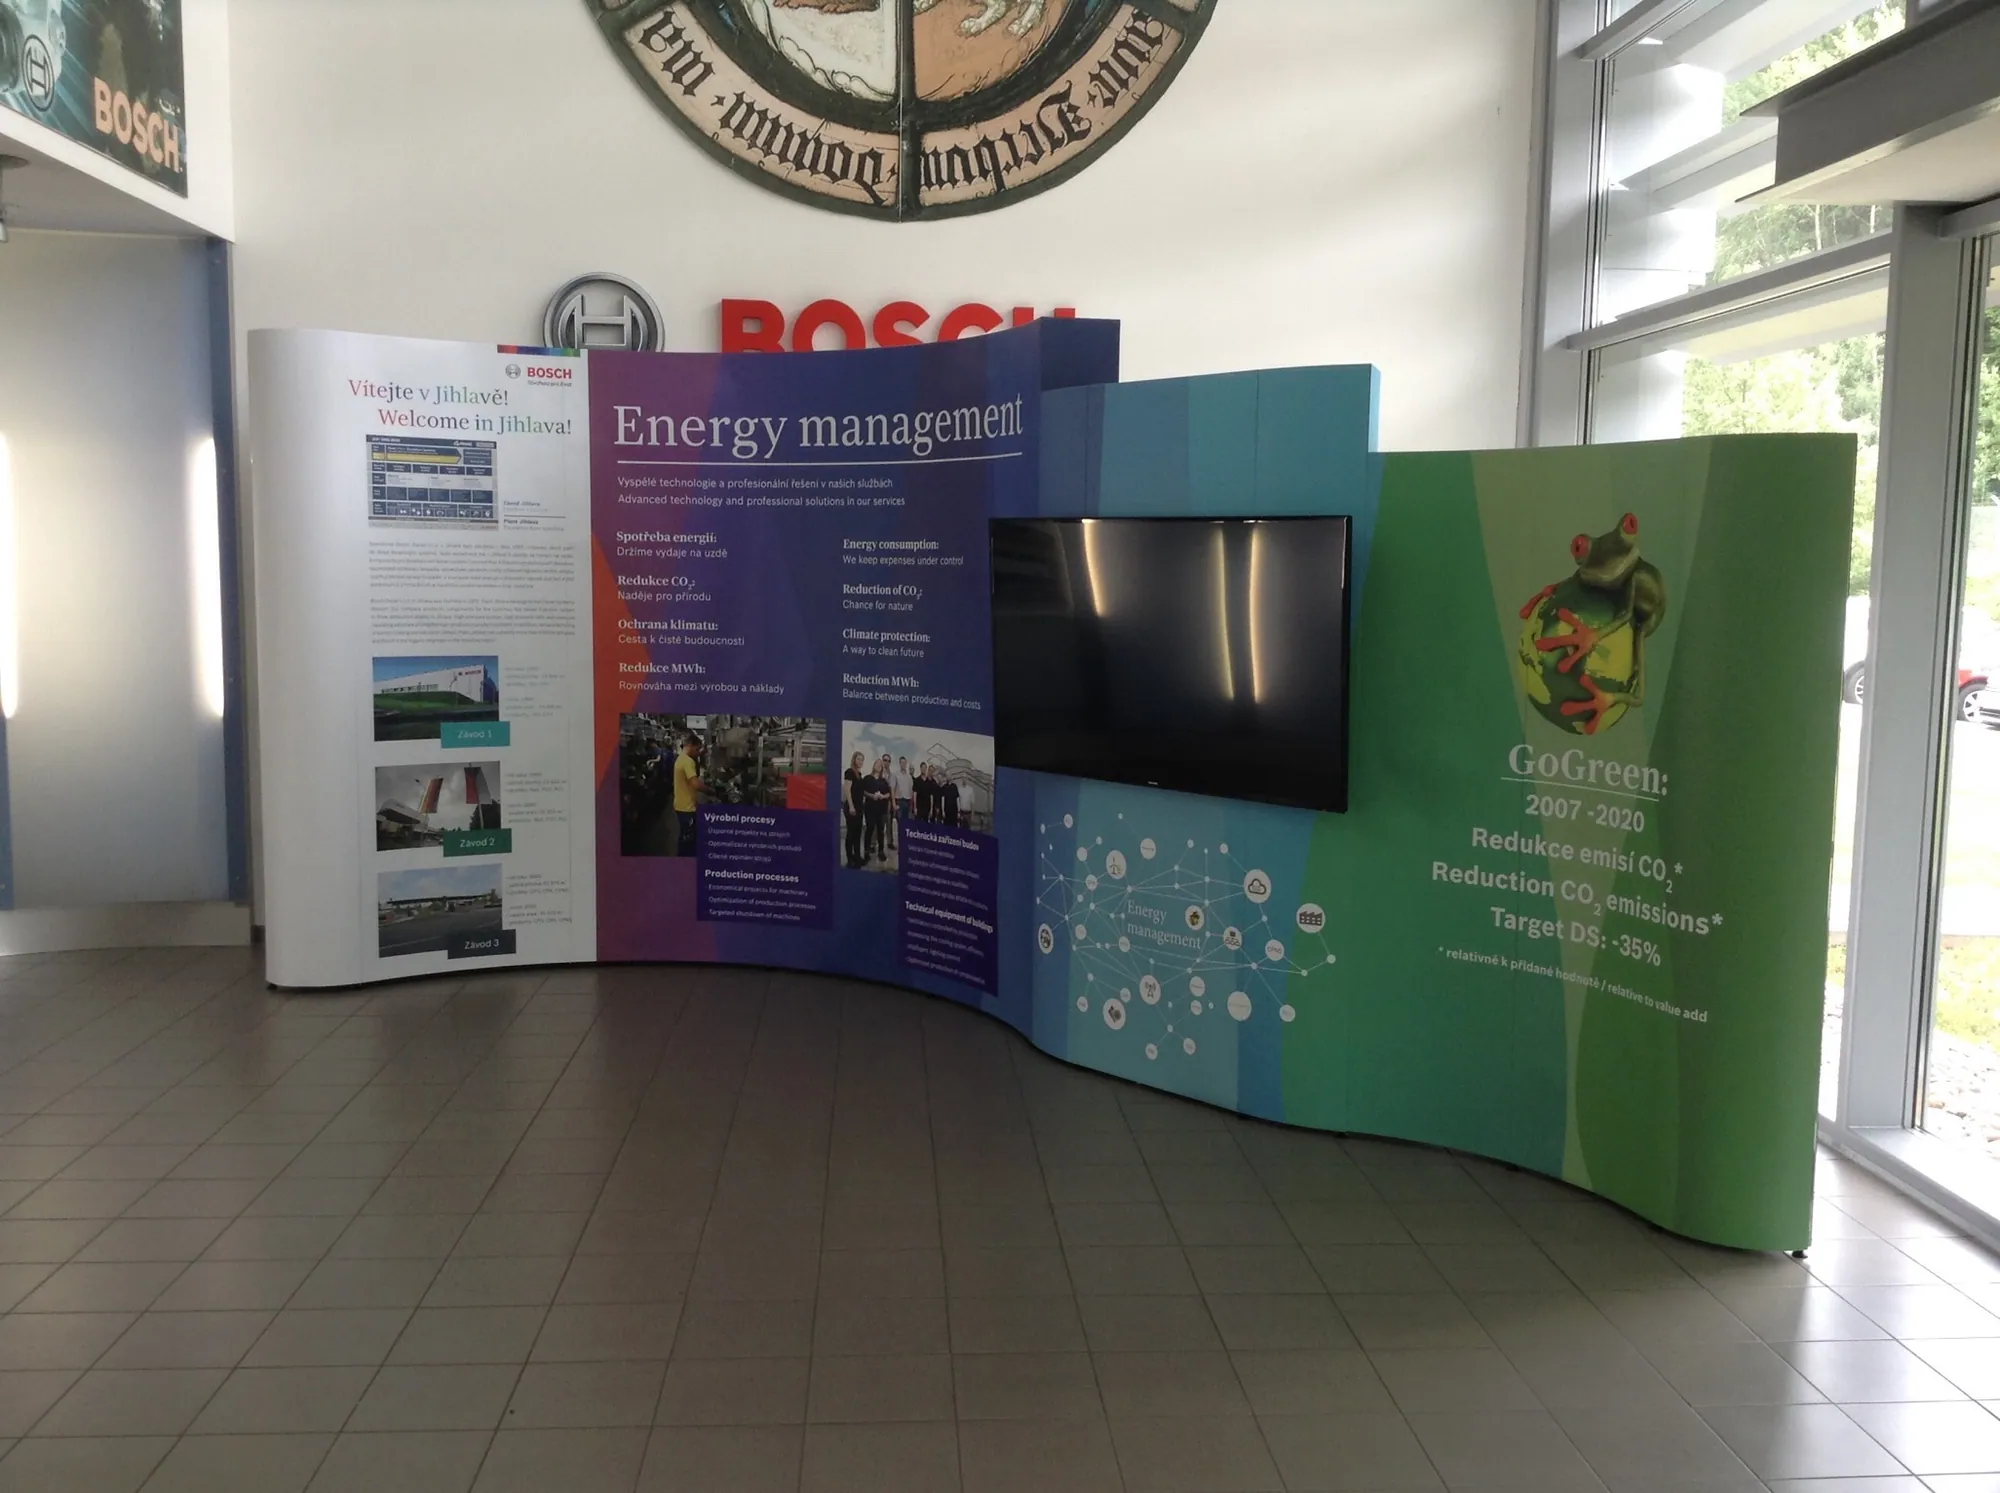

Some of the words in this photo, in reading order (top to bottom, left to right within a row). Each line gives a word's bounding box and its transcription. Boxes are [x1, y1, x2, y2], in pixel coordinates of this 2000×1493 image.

[94, 77, 179, 173] BOSCH
[721, 297, 1079, 354] BOS
[527, 367, 572, 379] BOSCH
[349, 379, 413, 402] Vítejte
[420, 388, 430, 401] v
[433, 386, 509, 406] Jihlavě!
[378, 409, 469, 430] Welcome
[475, 413, 493, 432] in
[496, 415, 572, 436] Jihlava!
[613, 405, 788, 459] Energy
[799, 393, 1024, 456] management
[659, 477, 716, 490] technologie
[719, 480, 725, 488] a
[727, 477, 788, 490] profesionální
[829, 478, 855, 488] našich
[617, 494, 667, 505] Advanced
[670, 495, 723, 508] technology
[726, 496, 744, 506] and
[747, 497, 802, 509] professional
[805, 497, 845, 507] solutions
[847, 497, 855, 506] in
[857, 498, 871, 506] our
[873, 497, 905, 507] services
[616, 530, 671, 544] Spotřeba
[690, 549, 702, 558] na
[704, 547, 728, 558] uzdě
[843, 538, 877, 551] Energy
[879, 539, 939, 552] consumption:
[843, 554, 857, 564] We
[859, 554, 877, 566] keep
[880, 556, 915, 567] expenses
[917, 556, 938, 565] under
[939, 556, 964, 566] control
[617, 575, 669, 587] Redukce
[617, 590, 653, 603] Naděje
[655, 592, 673, 603] pro
[843, 584, 891, 596] Reduction
[893, 585, 902, 596] of
[843, 600, 873, 610] Chance
[875, 601, 886, 611] for
[888, 602, 913, 612] nature
[618, 619, 668, 631] Ochrana
[670, 619, 719, 631] klimatu:
[618, 633, 647, 644] Cesta
[650, 633, 656, 644] k
[684, 634, 745, 646] budoucnosti
[842, 628, 879, 641] Climate
[881, 631, 931, 644] protection:
[843, 645, 849, 654] A
[850, 647, 866, 657] way
[868, 646, 876, 655] to
[878, 646, 898, 657] clean
[900, 647, 925, 659] future
[619, 662, 669, 674] Redukce
[671, 663, 706, 675] MWh:
[843, 673, 889, 686] Reduction
[891, 676, 919, 688] MWh:
[619, 681, 672, 692] Rovnováha
[675, 682, 698, 692] mezi
[749, 683, 785, 696] náklady
[842, 688, 872, 699] Balance
[875, 690, 909, 702] between
[911, 694, 949, 707] production
[950, 696, 963, 708] and
[963, 698, 981, 710] costs
[487, 730, 492, 739] 1
[1508, 743, 1668, 796] GoGreen:
[1525, 794, 1582, 821] 2007
[704, 813, 739, 824] Výrobní
[741, 814, 776, 826] procesy
[905, 828, 937, 841] Technická
[460, 837, 488, 848] Závod
[489, 837, 495, 846] 2
[1471, 827, 1574, 860] Redukce
[1580, 847, 1634, 874] emisí
[705, 869, 754, 880] Production
[755, 872, 799, 884] processes
[1432, 861, 1555, 898] Reduction
[905, 900, 934, 914] Technical
[935, 906, 966, 923] equipment
[1127, 899, 1167, 922] Energy
[464, 939, 492, 949] Závod
[493, 939, 499, 947] 3
[1127, 923, 1201, 950] management
[1490, 906, 1564, 940] Target
[1570, 921, 1607, 949] DS:
[1612, 934, 1661, 967] -35%
[1501, 955, 1508, 968] k
[1601, 979, 1607, 992] /
[1607, 982, 1643, 1004] relative
[1644, 992, 1654, 1008] to
[1655, 997, 1681, 1016] value
[1683, 1006, 1708, 1023] add
